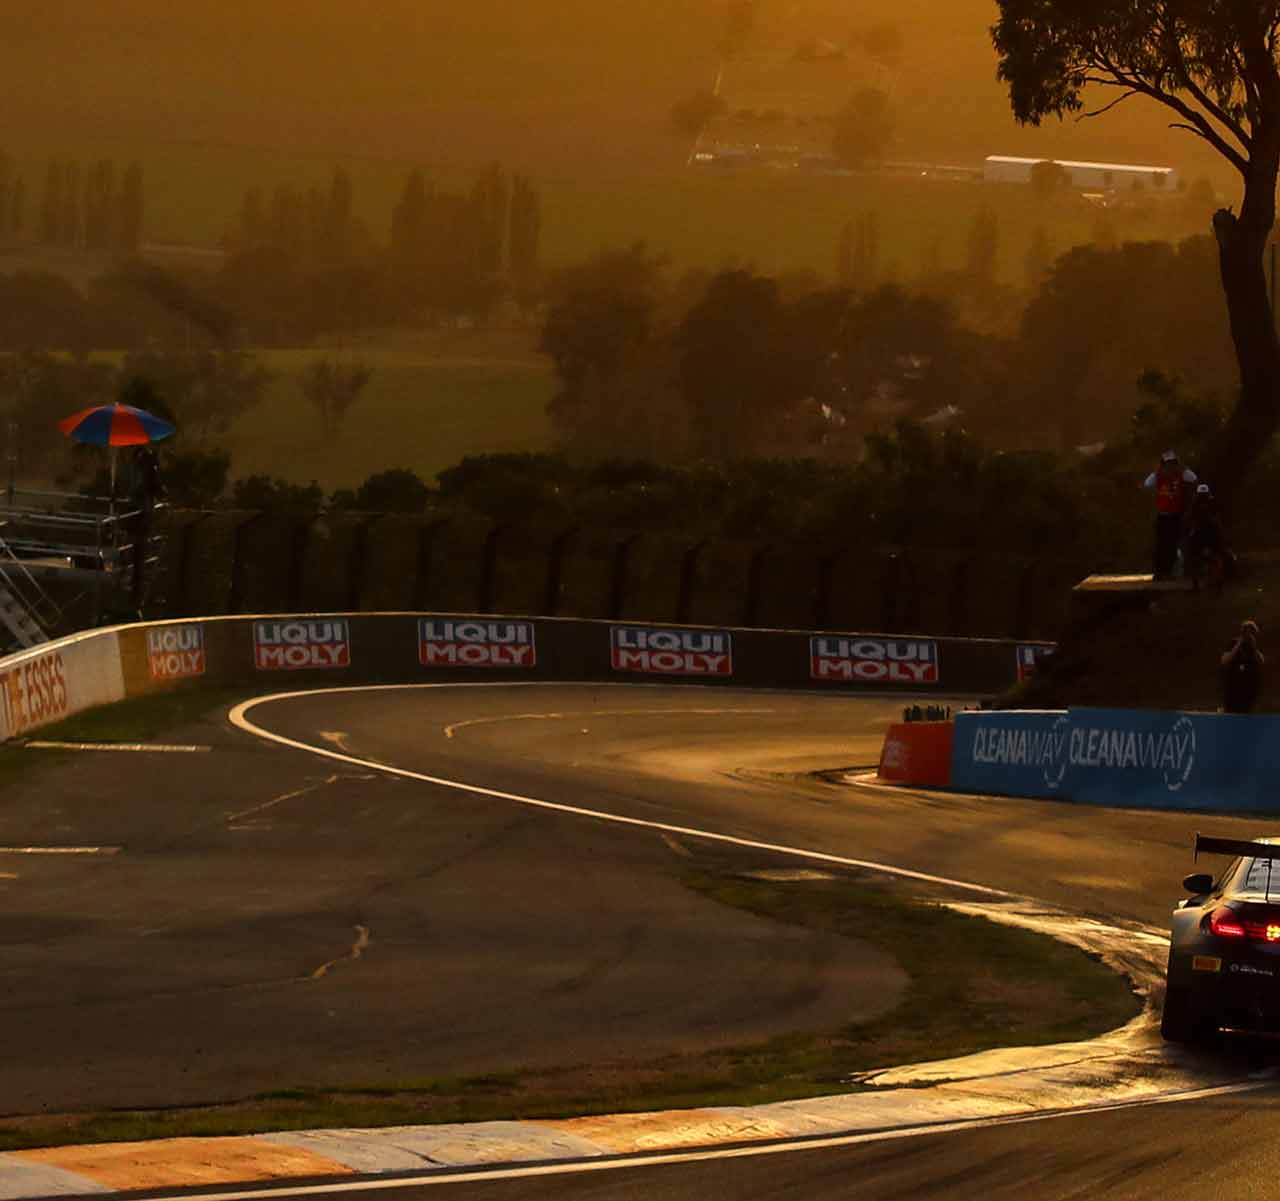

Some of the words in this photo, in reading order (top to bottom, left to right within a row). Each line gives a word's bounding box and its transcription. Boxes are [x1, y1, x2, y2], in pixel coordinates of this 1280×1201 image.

[150, 627, 199, 654] LIQUI
[258, 622, 343, 645] LIQUI
[423, 622, 528, 643] LIQUI
[621, 628, 724, 652] LIQUI
[259, 644, 346, 667] MOLY
[424, 643, 532, 665] MOLY
[820, 638, 930, 661] LIQUI
[151, 651, 202, 676] MOLY
[621, 651, 728, 673] MOLY
[819, 659, 934, 681] MOLY
[24, 653, 66, 721] ESSES
[972, 727, 1066, 767] CLEANAWAY
[1069, 728, 1190, 769] CLEANAWAY
